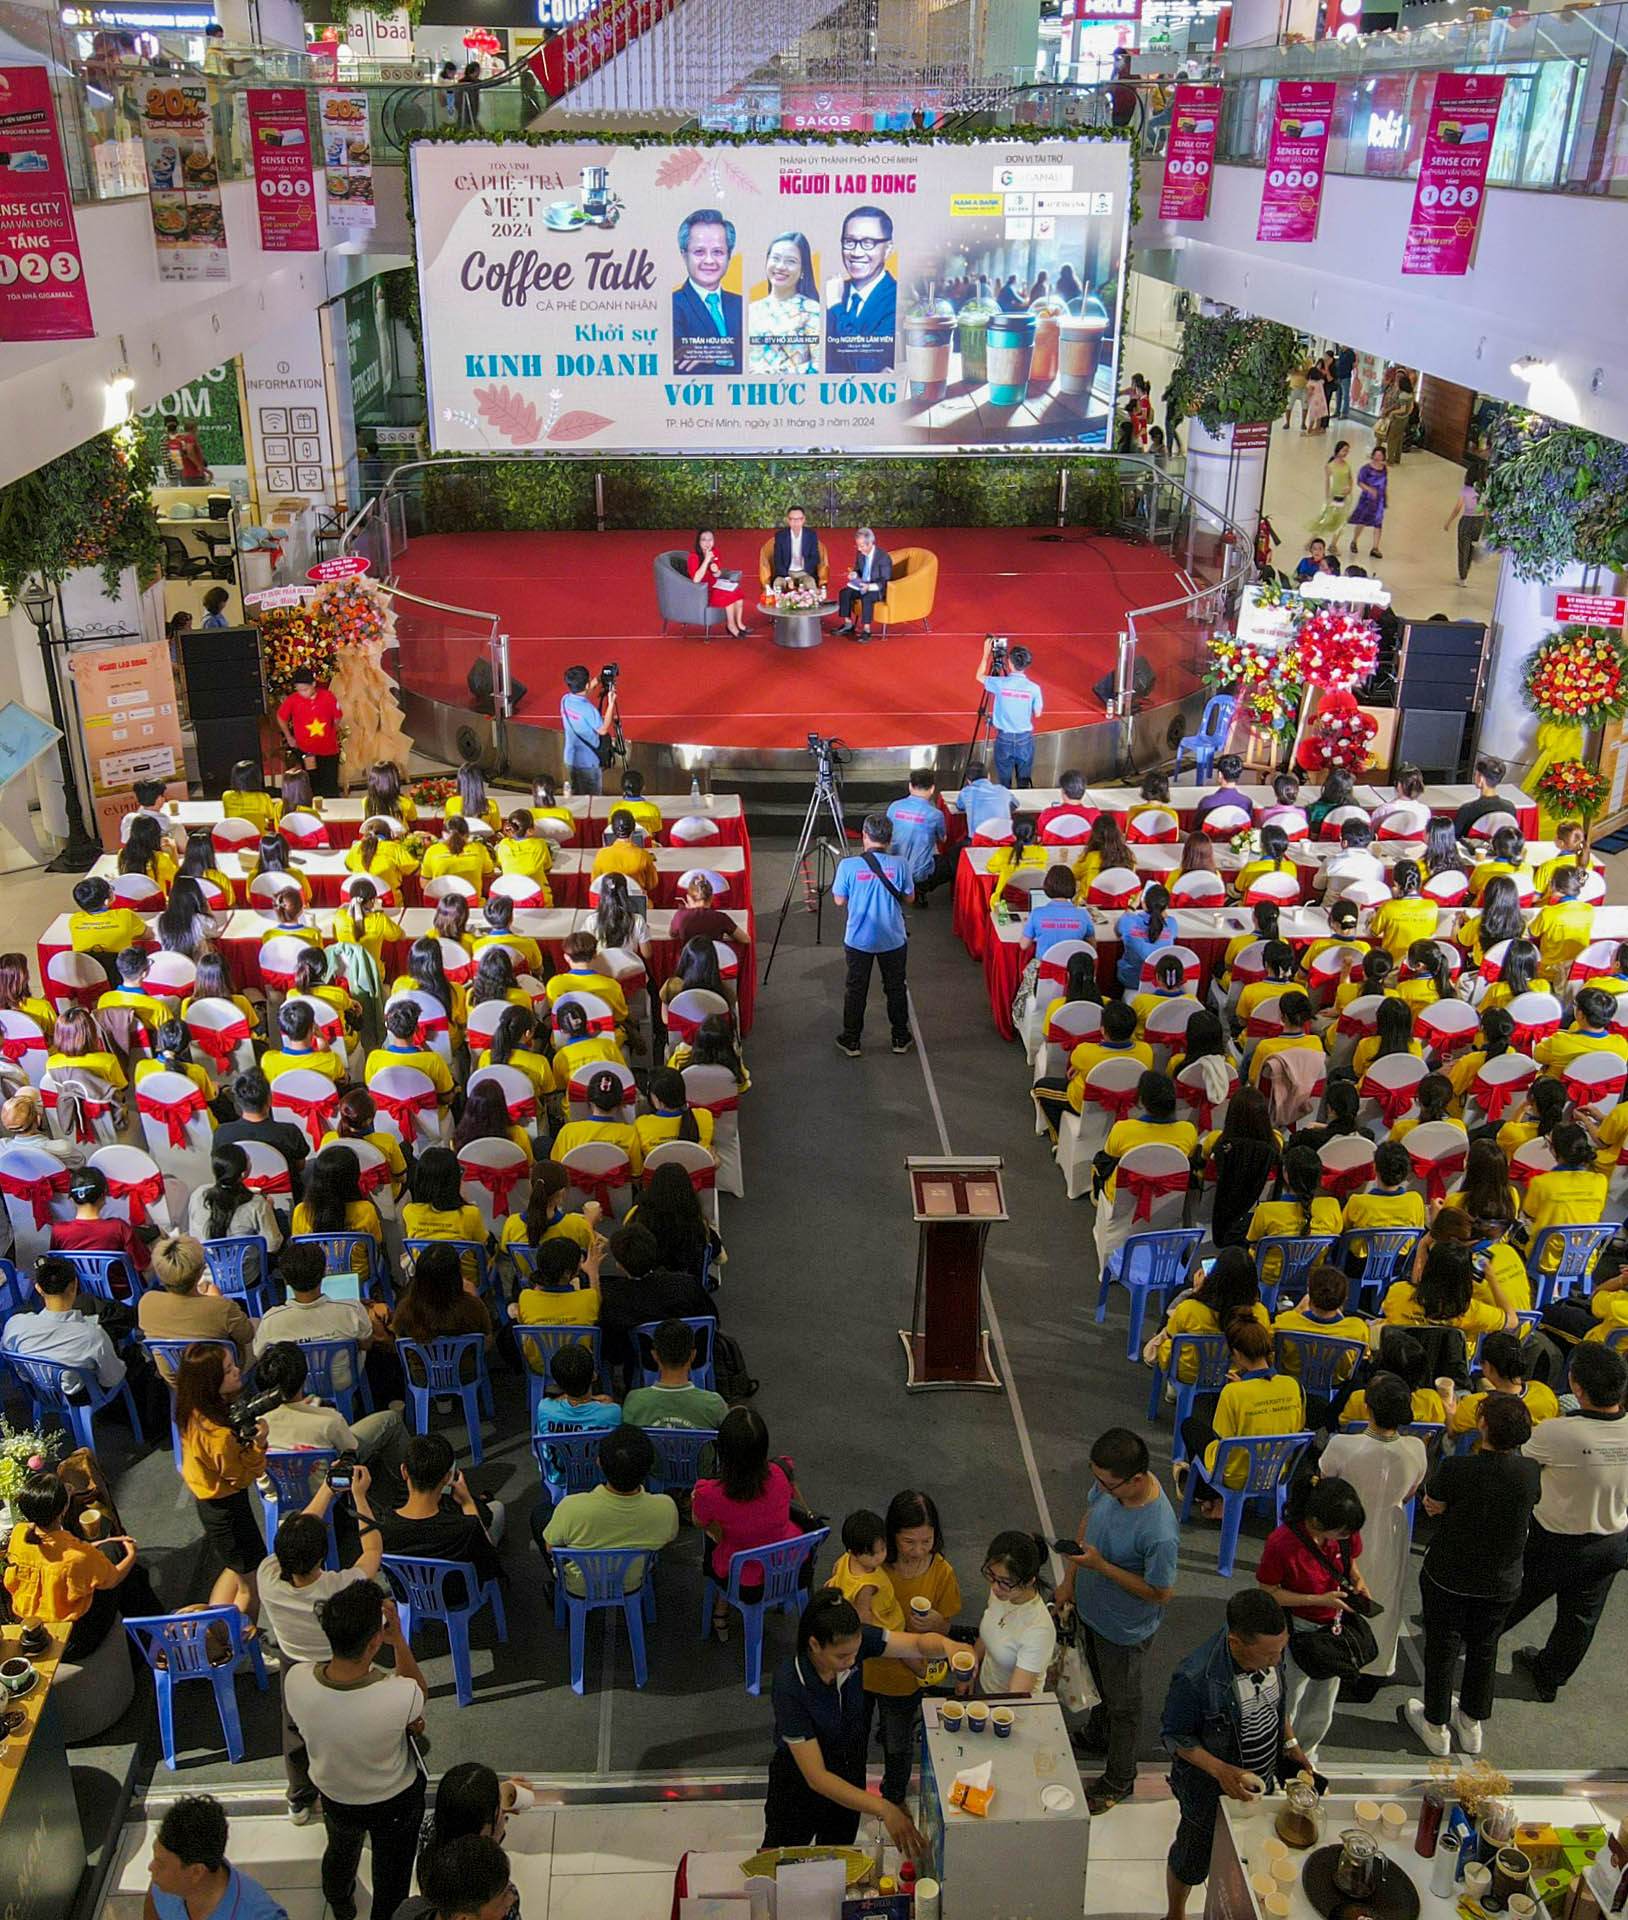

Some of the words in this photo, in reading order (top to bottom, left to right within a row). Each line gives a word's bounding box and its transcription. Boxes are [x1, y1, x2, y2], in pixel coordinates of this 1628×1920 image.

[146, 87, 199, 117] 20%
[326, 99, 363, 119] 20%
[795, 116, 851, 126] SAKOS
[1276, 147, 1300, 155] SENSE
[1302, 147, 1320, 155] CITY
[261, 156, 286, 164] SENSE
[287, 156, 304, 164] CITY
[1006, 154, 1024, 164] ĐƠN
[1430, 157, 1459, 167] SENSE
[1460, 157, 1481, 167] CITY
[509, 162, 530, 171] VINH
[1186, 163, 1192, 171] 2
[1200, 164, 1205, 172] 3
[835, 174, 867, 194] LAO
[1275, 174, 1280, 183] 1
[1290, 174, 1297, 184] 2
[1307, 174, 1314, 184] 3
[266, 183, 271, 192] 1
[282, 184, 288, 192] 2
[300, 183, 306, 192] 3
[1427, 190, 1433, 201] 1
[1446, 190, 1453, 201] 2
[1466, 191, 1472, 202] 3
[0, 204, 27, 217] NSE
[30, 202, 60, 215] CITY
[491, 223, 532, 238] 2024
[0, 261, 8, 277] 1
[29, 258, 42, 276] 2
[57, 256, 70, 275] 3
[461, 250, 575, 307] Coffee
[585, 248, 657, 291] Talk
[536, 300, 553, 311] CÀ
[580, 300, 623, 311] DOANH
[624, 300, 658, 310] NHÂN
[575, 323, 624, 342] Khởi
[632, 327, 658, 346] sự
[465, 354, 542, 378] KINH
[556, 354, 658, 377] DOANH
[248, 379, 323, 390] INFORMATION
[664, 379, 714, 406] VỚI
[728, 378, 806, 406] THỨC
[819, 375, 897, 406] UỐNG
[666, 419, 678, 428] TP.
[680, 417, 694, 428] Hồ
[698, 418, 714, 428] Chí
[745, 419, 772, 430] ngày
[773, 419, 784, 427] 31
[786, 418, 816, 430] tháng
[819, 418, 825, 427] 3
[827, 418, 850, 427] năm
[852, 418, 875, 427] 2024
